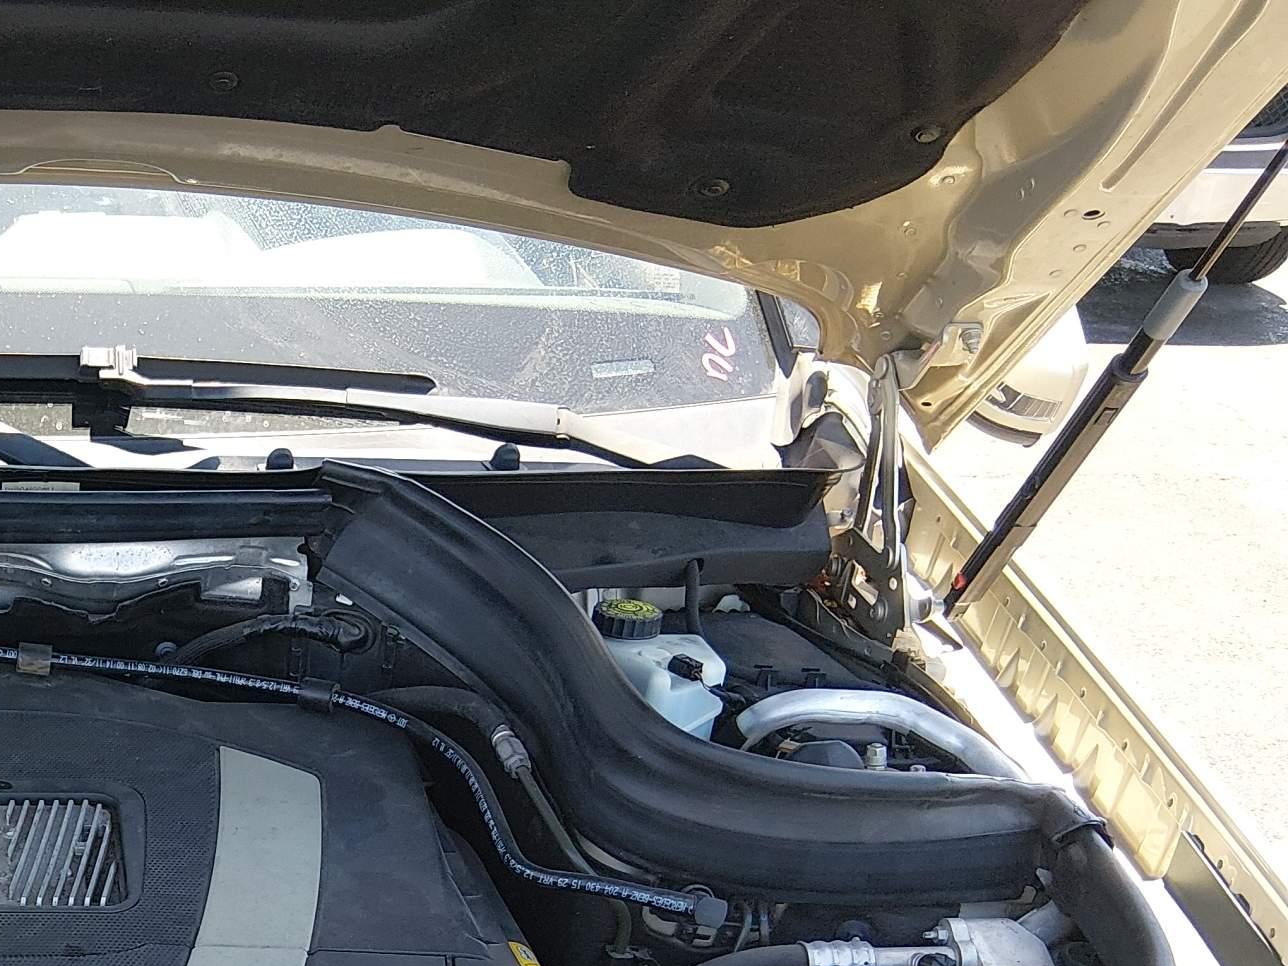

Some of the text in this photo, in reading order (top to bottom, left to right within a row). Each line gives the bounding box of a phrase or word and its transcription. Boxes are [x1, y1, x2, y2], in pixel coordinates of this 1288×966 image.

[537, 876, 554, 886] VRT
[557, 878, 569, 888] 29
[571, 880, 581, 890] 15
[585, 883, 602, 893] 430
[621, 887, 628, 897] A
[629, 890, 688, 913] MERCEDES-BENZ
